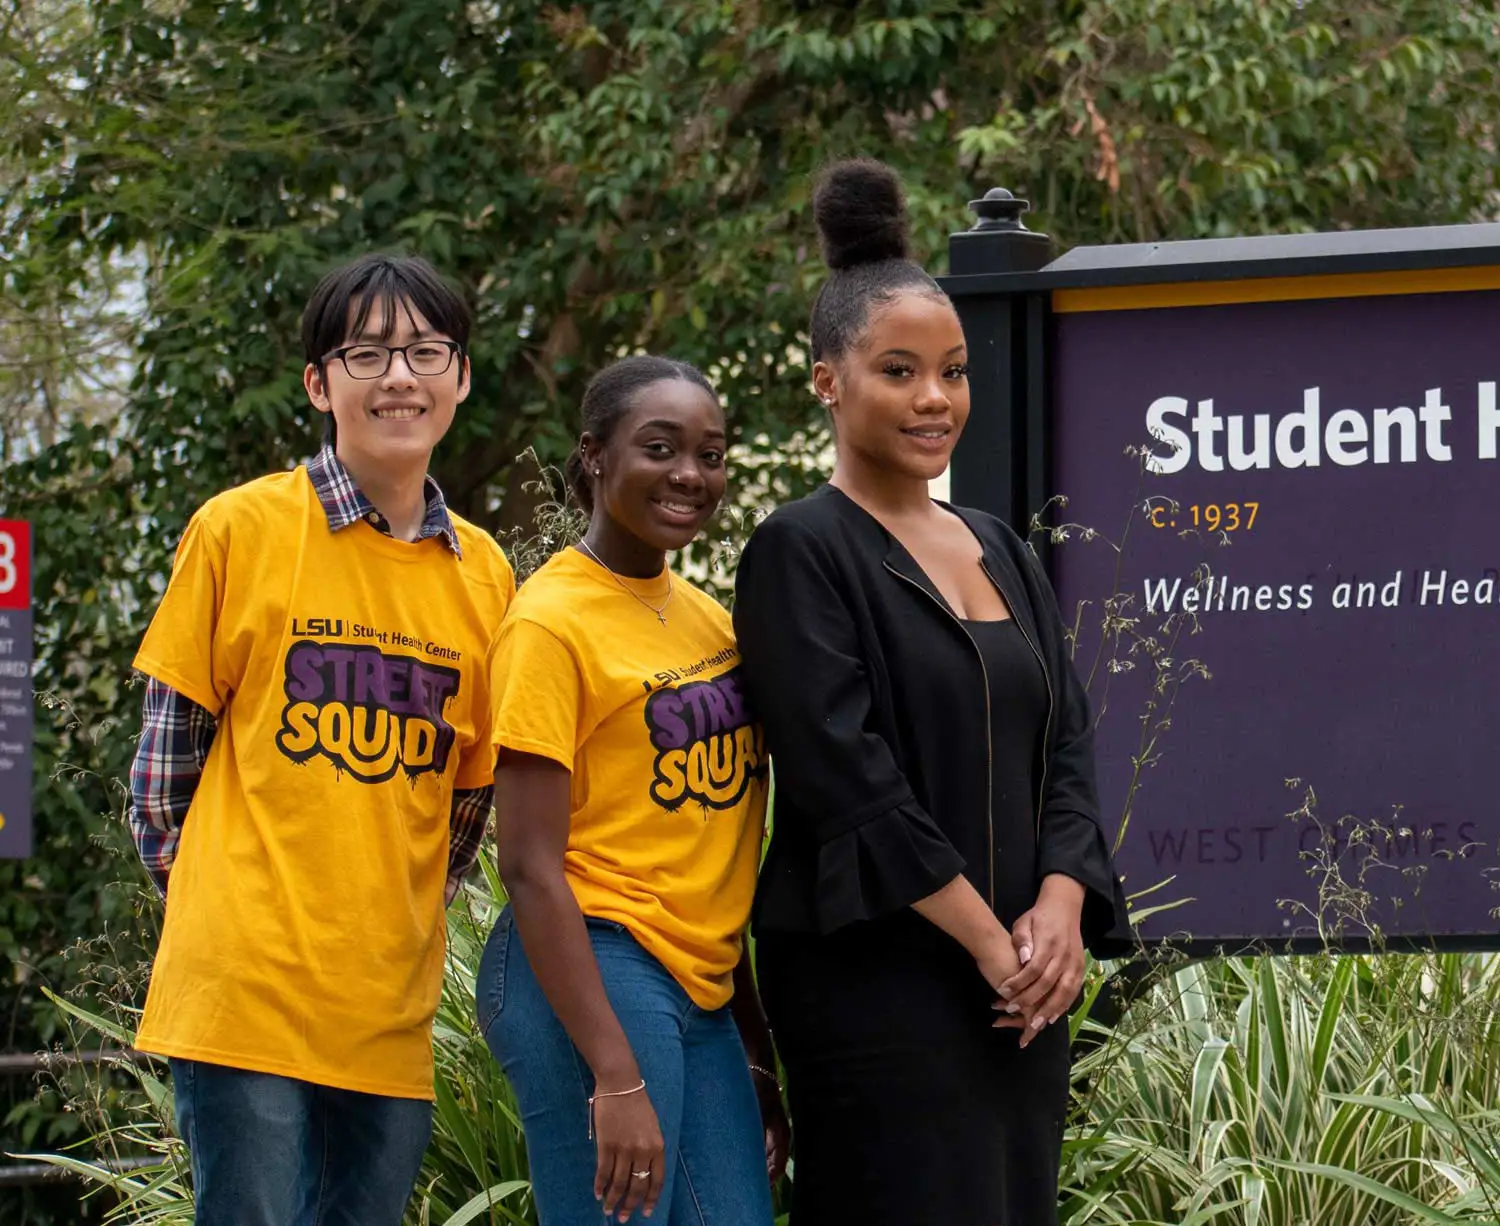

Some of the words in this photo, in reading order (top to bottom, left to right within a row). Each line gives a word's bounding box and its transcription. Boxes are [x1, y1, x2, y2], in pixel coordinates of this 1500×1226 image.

[1145, 386, 1453, 474] Student
[1151, 506, 1176, 528] c.
[1190, 502, 1259, 532] 1937
[1144, 575, 1314, 612] Wellness
[1332, 570, 1402, 608] and
[291, 618, 343, 637] LSU
[425, 641, 461, 662] Center
[705, 646, 736, 669] Health
[1148, 826, 1276, 867] WEST
